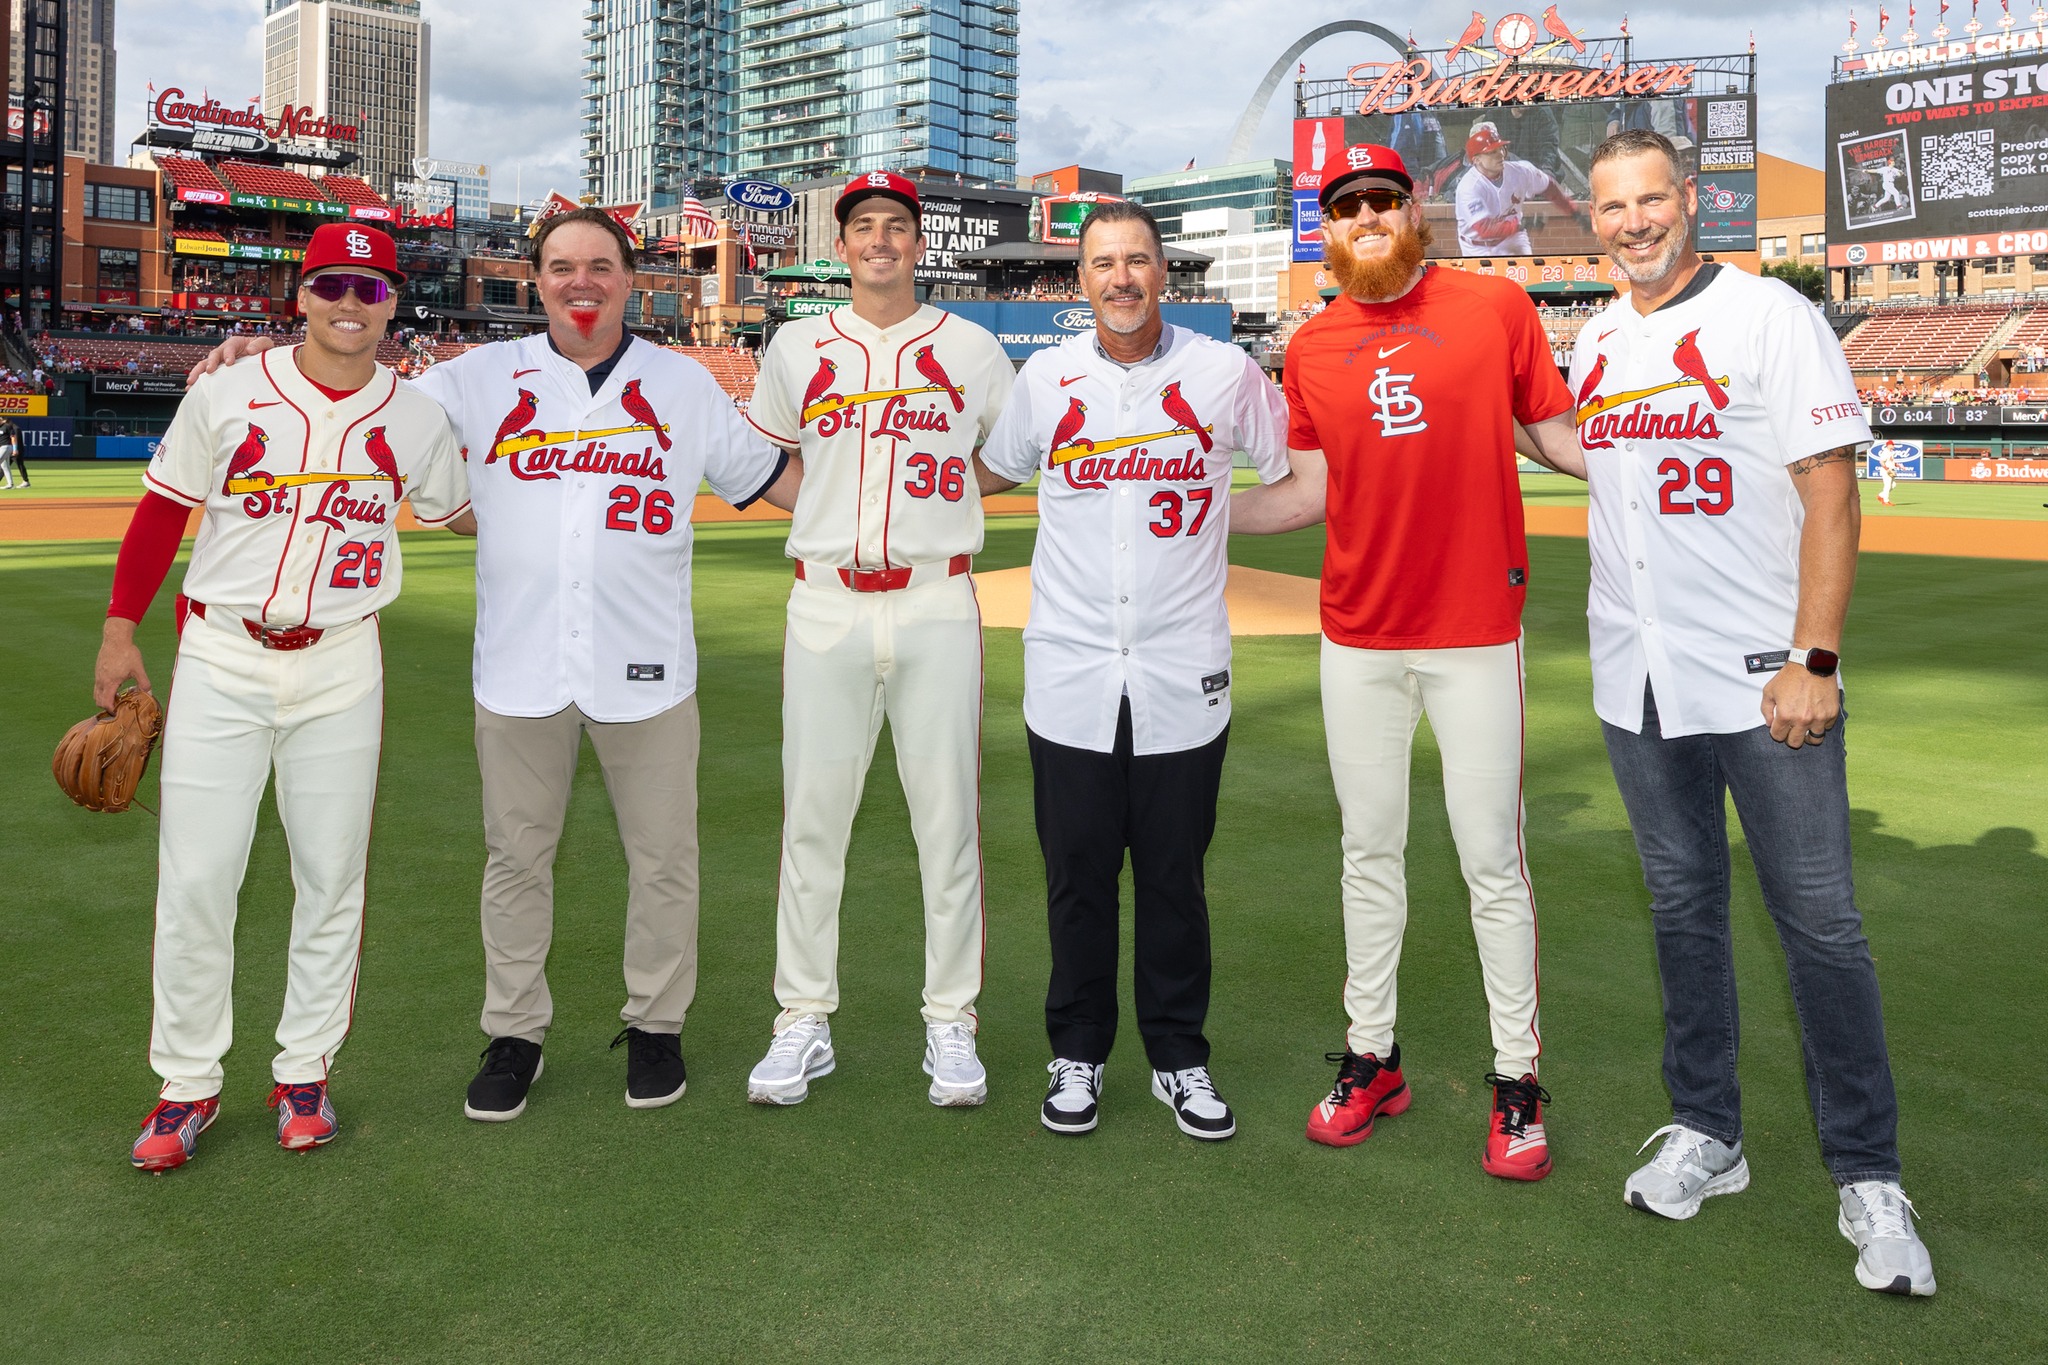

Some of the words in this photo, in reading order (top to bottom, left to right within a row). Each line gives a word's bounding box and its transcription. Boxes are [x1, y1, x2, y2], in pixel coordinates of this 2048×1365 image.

[1863, 42, 1968, 72] WORLD
[1975, 29, 2048, 56] CHA
[1346, 53, 1695, 116] Budweiser
[1886, 74, 1972, 112] ONE
[155, 87, 267, 130] Cardinals
[267, 104, 359, 142] Nation
[1885, 112, 1922, 125] TWO
[1926, 106, 1970, 120] WAYS
[1973, 101, 1995, 115] TO
[1998, 94, 2048, 112] EXPE
[192, 130, 257, 149] HOFFMANN
[1840, 130, 1859, 139] Book!
[277, 144, 341, 160] ROOFTOP
[1847, 147, 1862, 157] THE
[1863, 138, 1899, 150] HARDEST
[2001, 138, 2048, 153] Preord
[1701, 151, 1754, 165] DISASTER
[1854, 147, 1893, 163] COMEBACK
[2001, 153, 2035, 165] copy
[2001, 164, 2037, 177] book
[184, 190, 217, 200] HOFFMANN
[255, 195, 267, 208] KC
[272, 199, 277, 208] 1
[305, 202, 311, 211] 2
[741, 183, 783, 207] Ford
[355, 208, 384, 217] HOFFMANN
[918, 201, 961, 214] TPHORM
[395, 204, 455, 230] Live!
[921, 214, 960, 233] ROM
[964, 218, 999, 236] THE
[732, 219, 794, 238] Community
[180, 243, 205, 251] Edward
[750, 233, 785, 245] merica
[947, 234, 986, 252] AND
[1882, 237, 1968, 261] BROWN
[1975, 241, 1991, 255] &
[1997, 231, 2048, 254] CRO
[284, 250, 290, 259] 2
[917, 249, 962, 268] E'R
[1849, 249, 1864, 259] BC
[1505, 266, 1528, 282] 20
[1542, 266, 1563, 282] 23
[1574, 265, 1597, 281] 24
[793, 302, 835, 314] SAFETY
[997, 334, 1030, 344] TRUCK
[1032, 335, 1054, 344] AND
[1355, 327, 1387, 351] LOUIS
[1391, 323, 1445, 348] BASEBALL
[106, 381, 133, 392] Mercy
[818, 392, 861, 438] St.
[870, 395, 951, 443] Louis
[1580, 394, 1723, 450] Cardinals
[1811, 402, 1862, 426] STIFEL
[1903, 410, 1933, 422] 6:04
[1965, 410, 1988, 422] 83°
[2012, 411, 2040, 423] Mercy
[21, 430, 71, 447] TIFEL
[509, 429, 667, 481] Cardinals
[1065, 438, 1208, 490] Cardinals
[1995, 463, 2048, 478] Budwe
[904, 452, 966, 502] 36
[1855, 468, 1865, 478] 5'
[1657, 457, 1734, 516] 29
[243, 471, 293, 519] St.
[304, 480, 387, 533] Louis
[605, 484, 675, 535] 26
[1149, 487, 1213, 538] 37
[329, 541, 384, 588] 26
